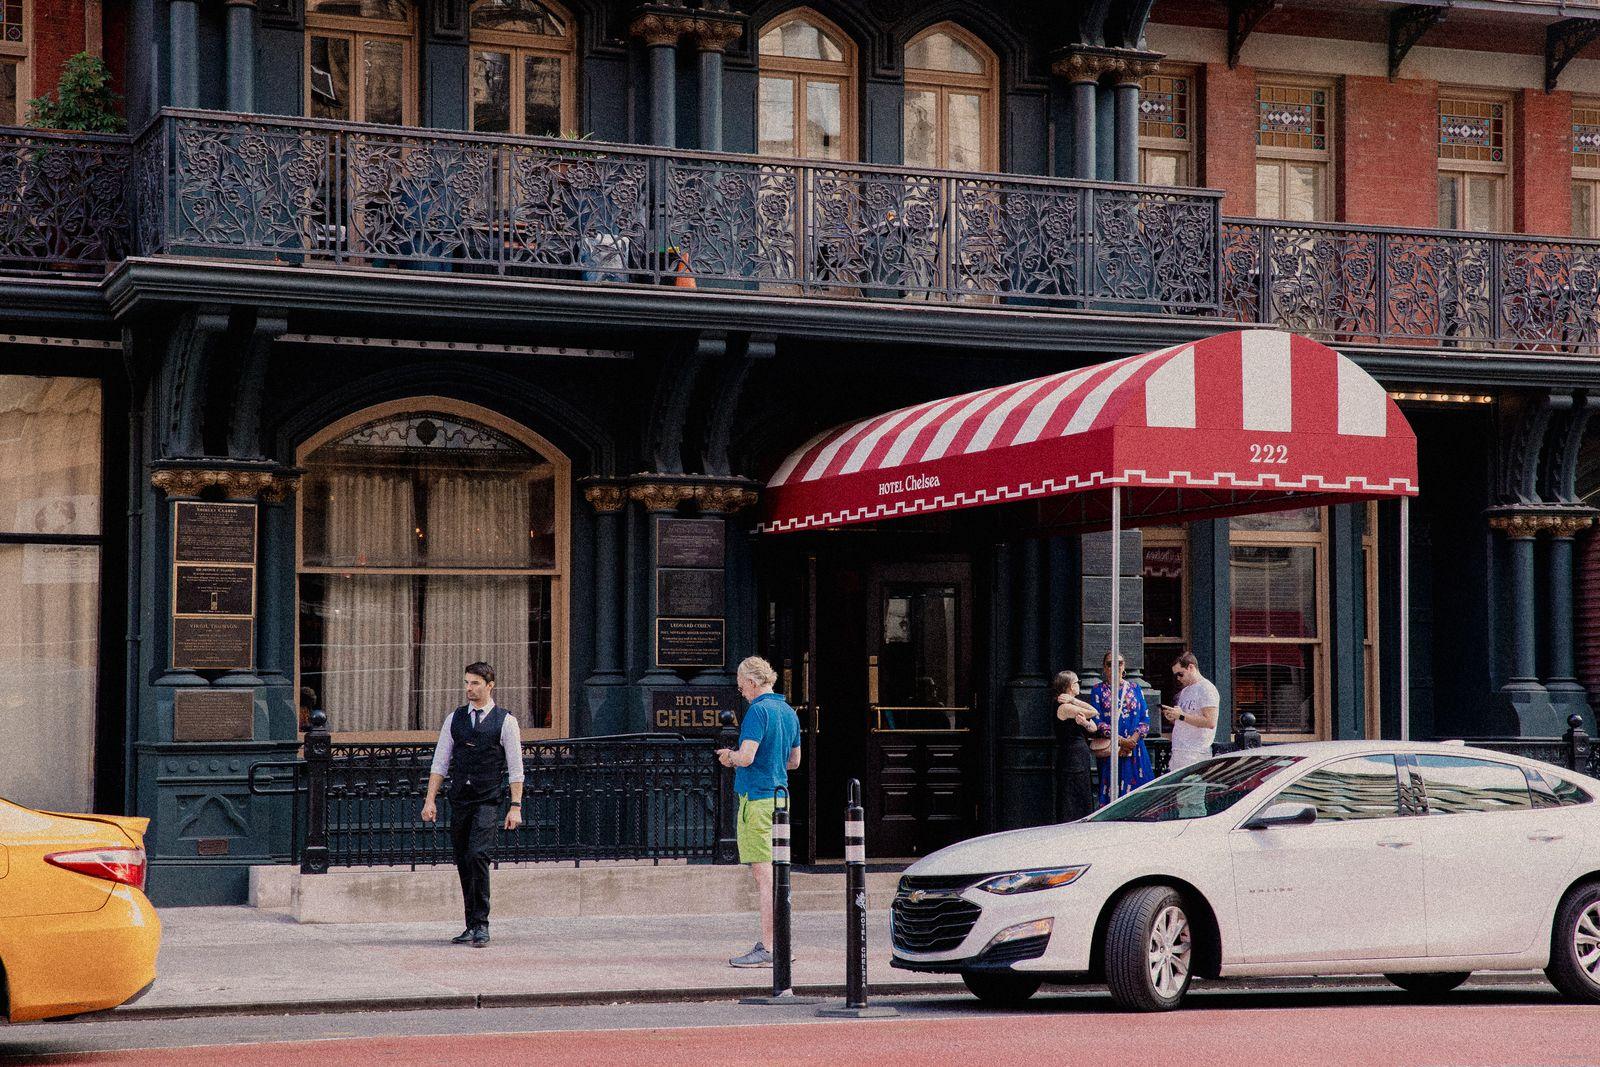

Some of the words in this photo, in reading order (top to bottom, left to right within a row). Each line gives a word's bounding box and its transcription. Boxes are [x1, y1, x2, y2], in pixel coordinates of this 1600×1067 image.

[1249, 443, 1289, 465] 222
[878, 480, 905, 496] HOTEL
[905, 473, 941, 492] Chelsea
[675, 695, 719, 706] HOTEL
